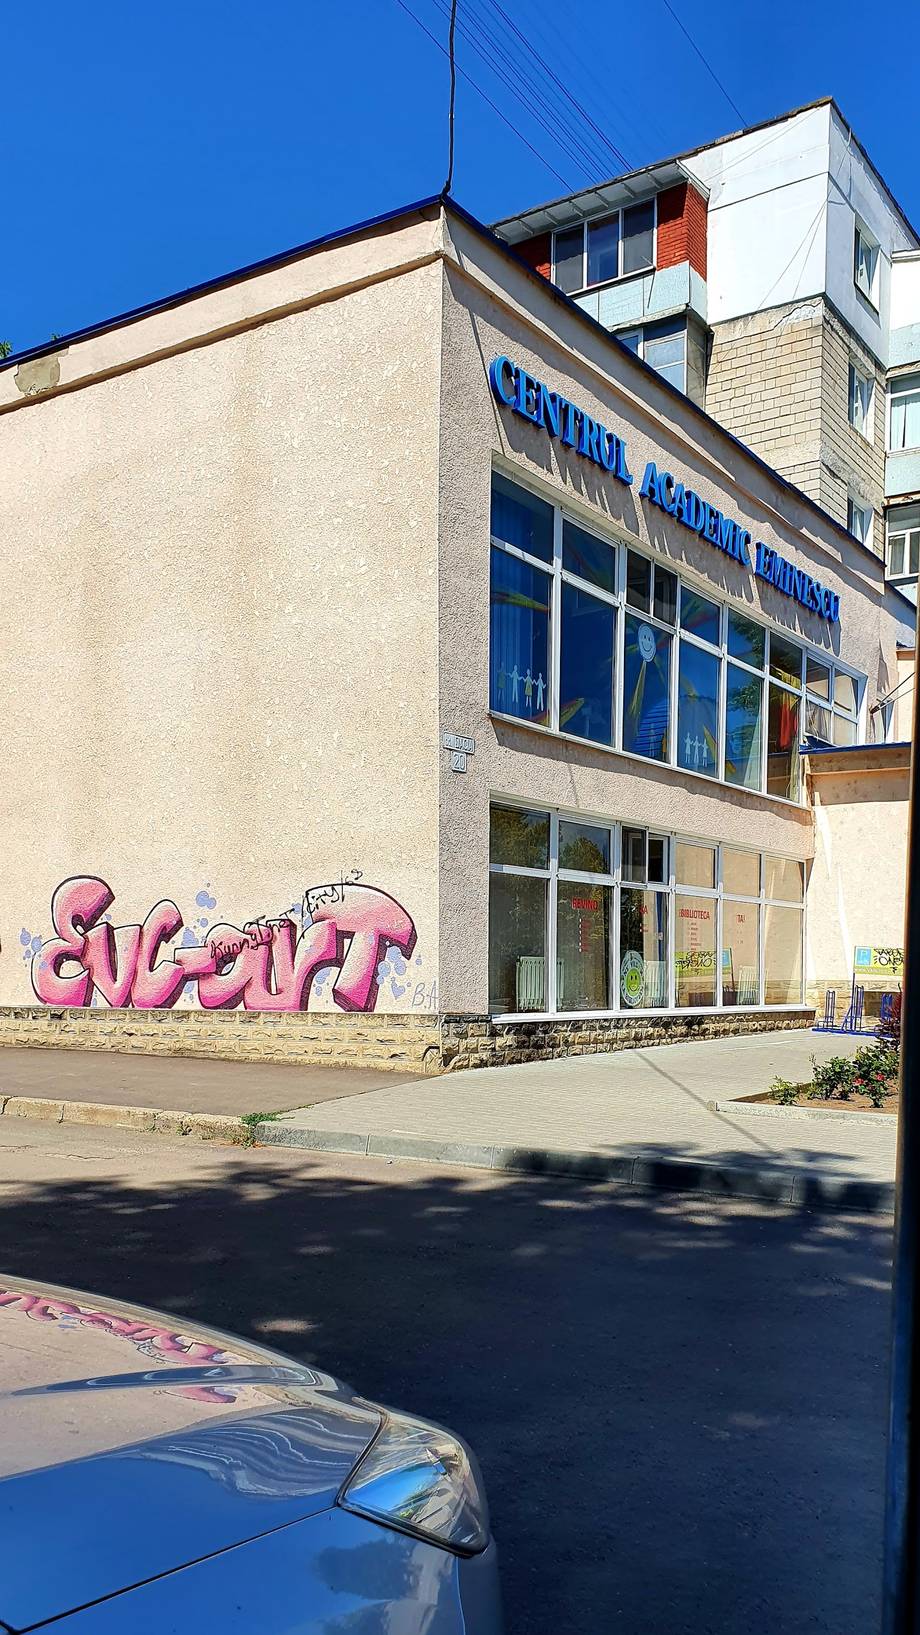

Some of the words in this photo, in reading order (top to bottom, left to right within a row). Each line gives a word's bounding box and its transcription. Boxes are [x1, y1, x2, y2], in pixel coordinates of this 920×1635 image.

[490, 355, 633, 486] CENTRUL
[639, 461, 751, 566] ACADEMIC
[755, 541, 840, 622] EMINESCU
[679, 904, 710, 920] BIBLIOTECA
